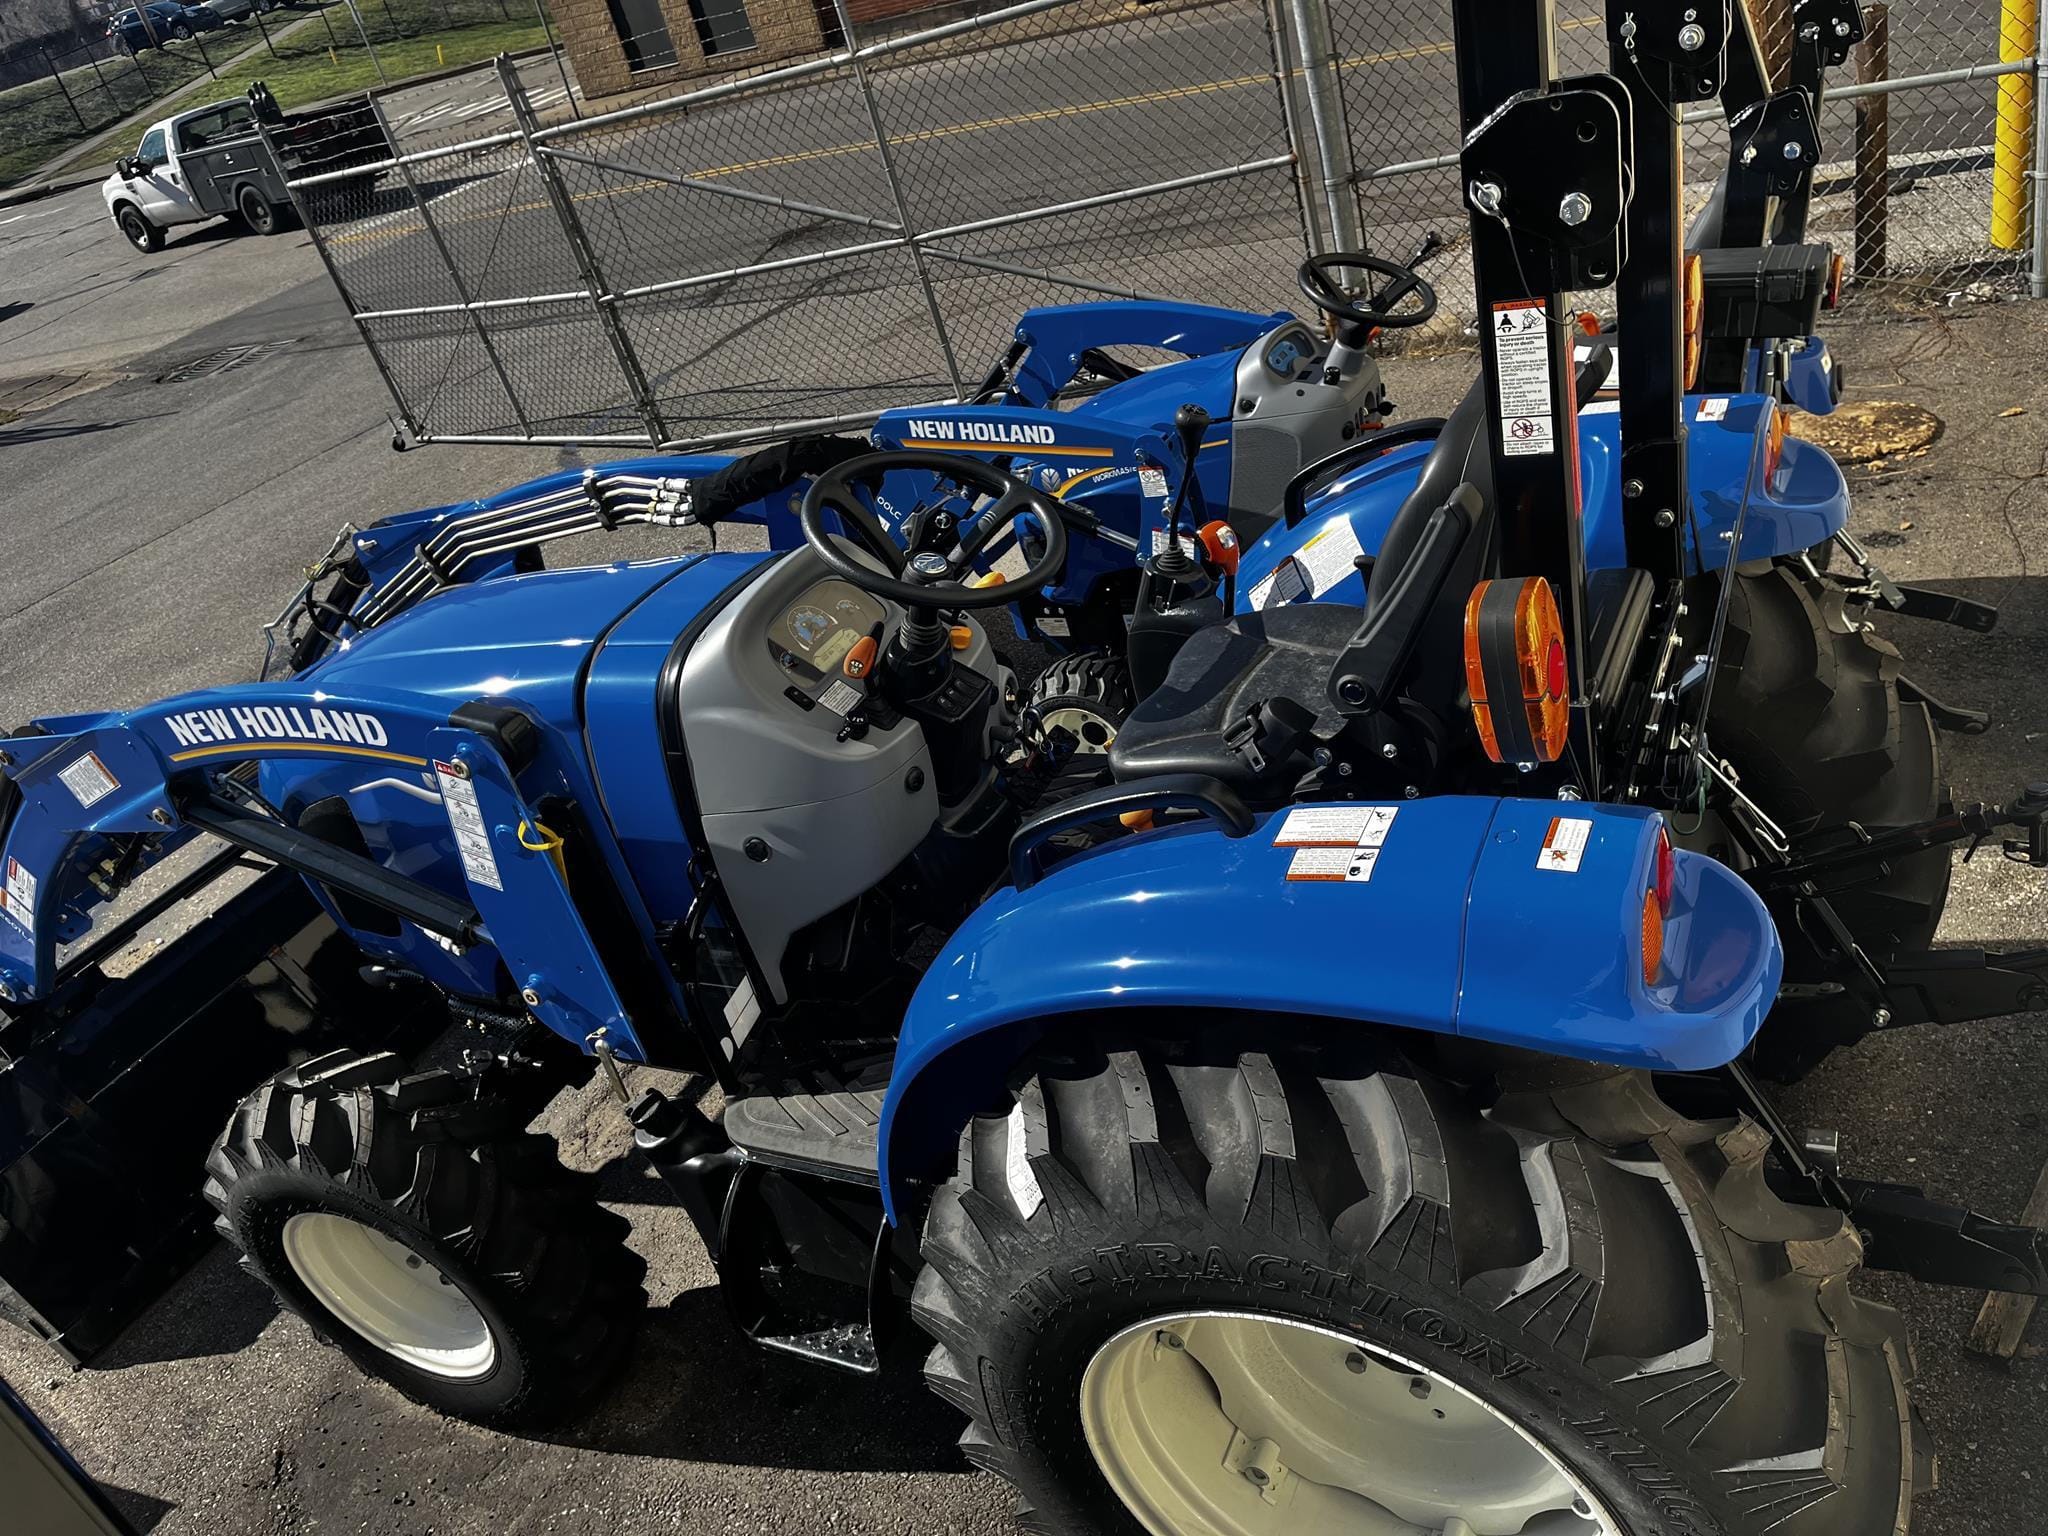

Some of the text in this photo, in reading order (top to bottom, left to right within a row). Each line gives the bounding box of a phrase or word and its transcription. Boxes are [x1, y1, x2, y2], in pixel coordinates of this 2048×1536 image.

[908, 420, 1055, 445] NEW HOLLAND
[1092, 466, 1137, 483] WORKMASTE
[164, 706, 388, 747] NEW HOLLAND
